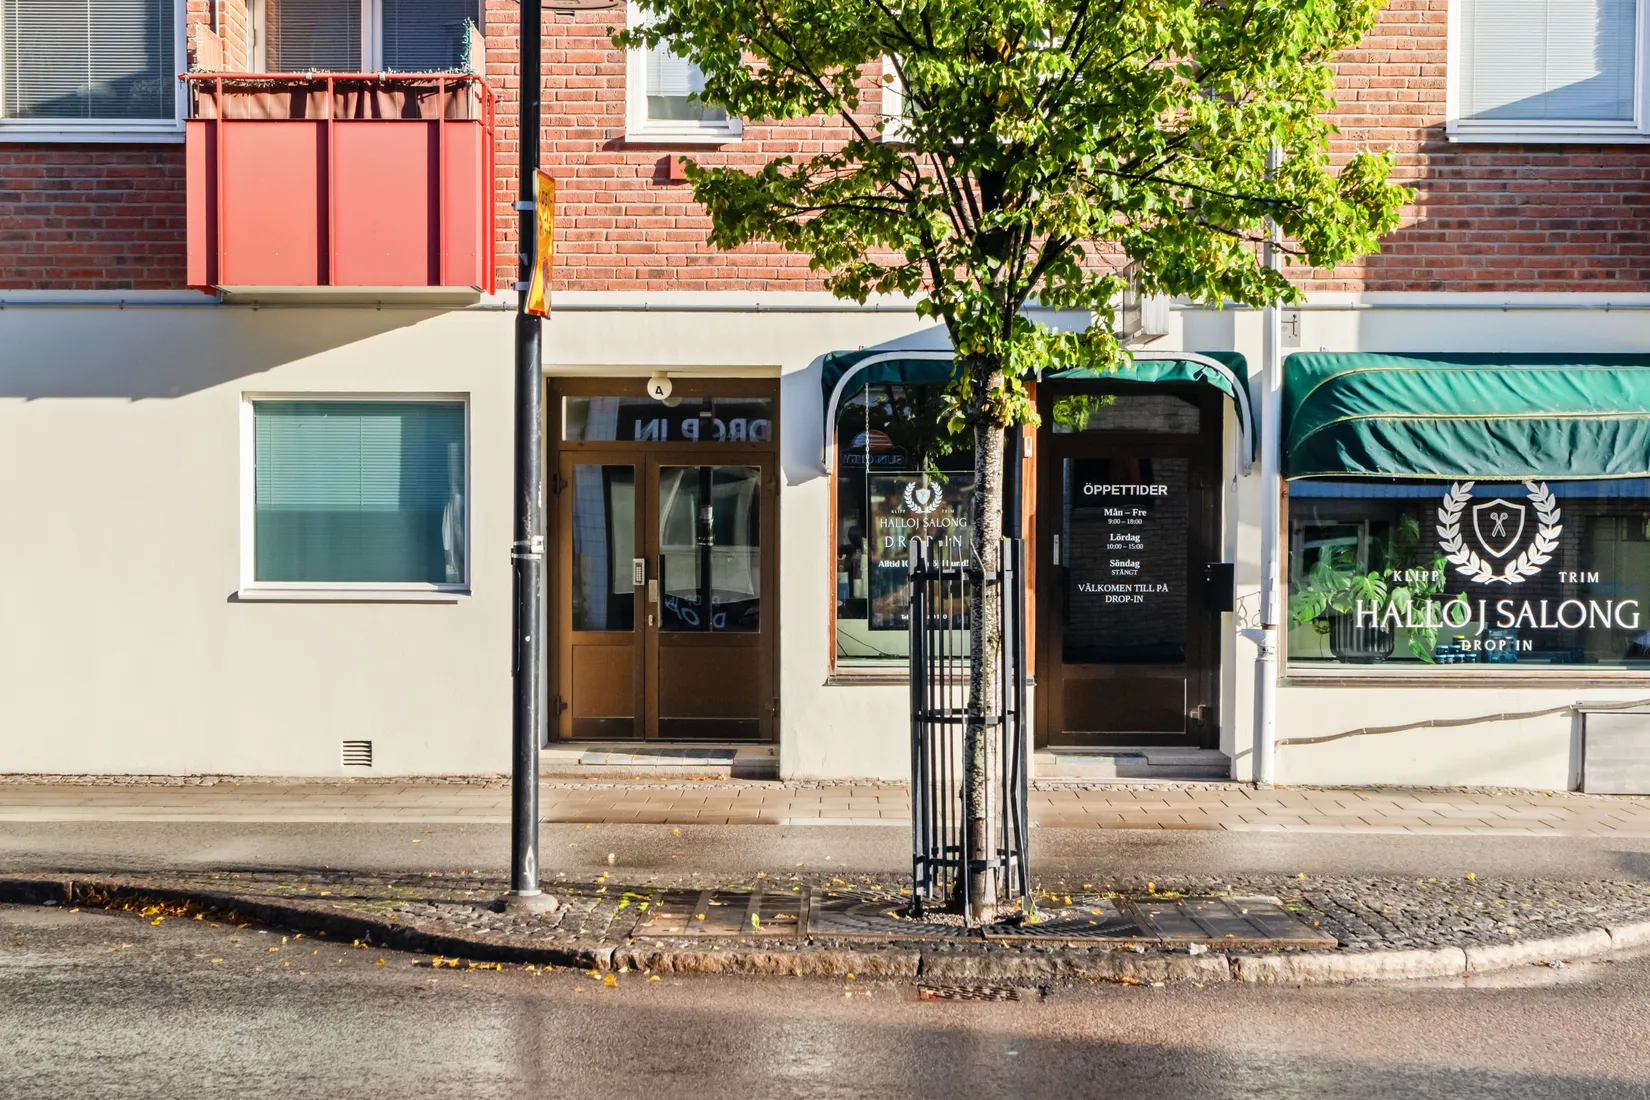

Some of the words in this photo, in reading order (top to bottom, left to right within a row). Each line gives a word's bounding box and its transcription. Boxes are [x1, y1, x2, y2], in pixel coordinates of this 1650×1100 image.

[655, 385, 664, 396] A
[1083, 482, 1168, 496] ÖPPETTIDER
[1104, 508, 1123, 516] Mån
[880, 518, 919, 530] HALLOJ
[923, 517, 967, 529] SALONG
[1110, 533, 1140, 542] Lördag
[878, 560, 900, 568] Alltid
[1110, 559, 1140, 569] Söndag
[1393, 570, 1440, 582] KLIPP
[1558, 571, 1599, 583] TRIM
[1078, 582, 1133, 593] VÄLKOMEN
[1134, 584, 1154, 592] TILL
[1157, 582, 1169, 592] PÅ
[1105, 594, 1144, 604] DROP-IN
[1355, 599, 1489, 636] HALLOJ
[1496, 599, 1640, 629] SALONG
[1461, 639, 1508, 652] DROP
[1515, 639, 1533, 652] IN
